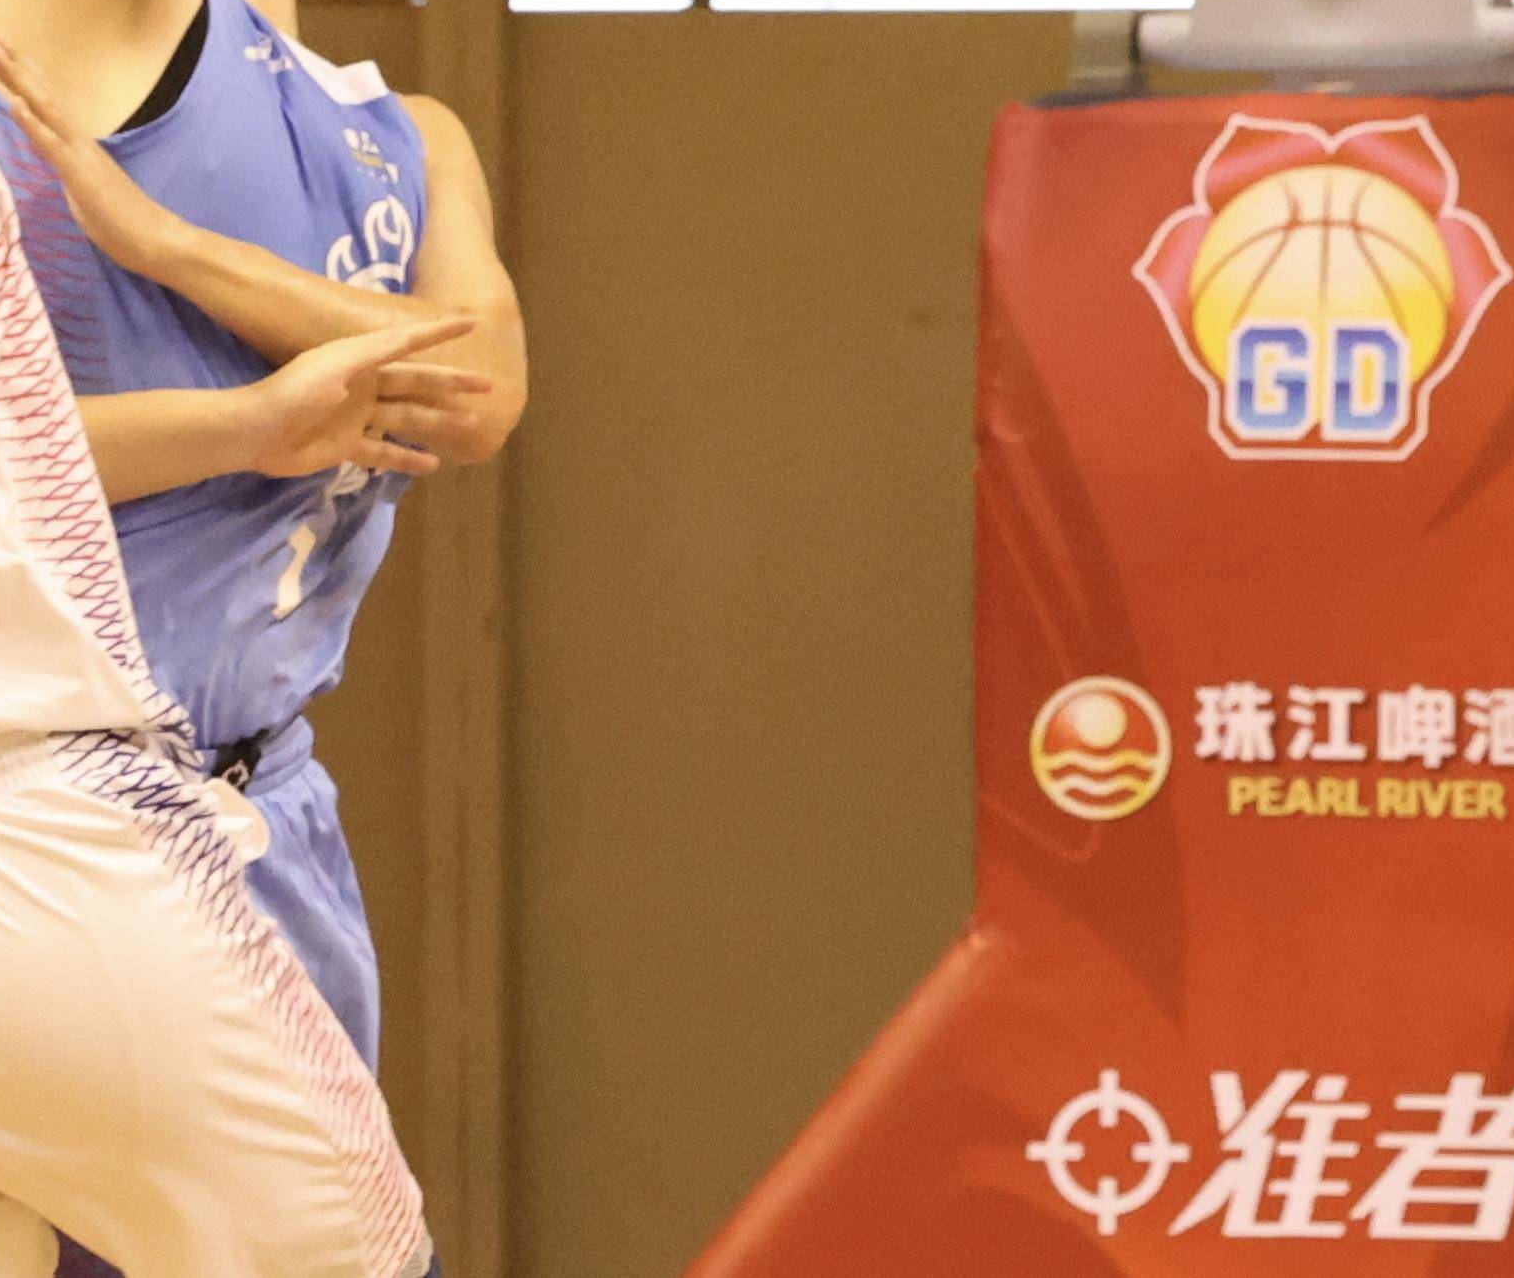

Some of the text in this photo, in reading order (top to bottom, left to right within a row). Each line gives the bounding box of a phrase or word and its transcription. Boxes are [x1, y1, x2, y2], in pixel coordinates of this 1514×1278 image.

[1228, 320, 1411, 442] GD
[1227, 778, 1508, 821] PEARL RIVER
